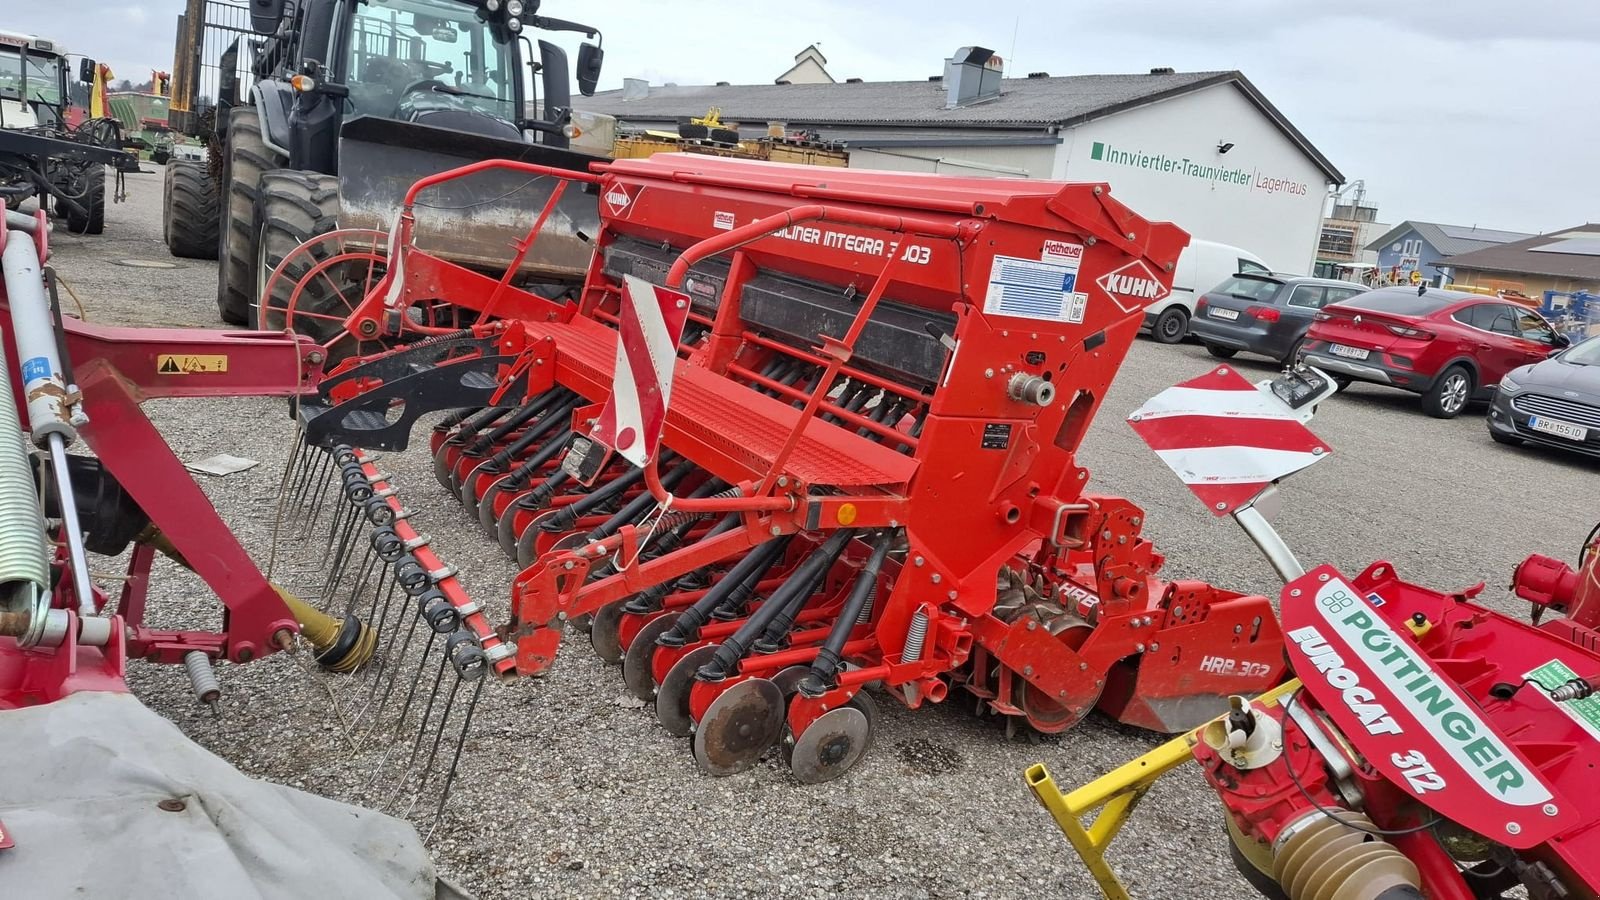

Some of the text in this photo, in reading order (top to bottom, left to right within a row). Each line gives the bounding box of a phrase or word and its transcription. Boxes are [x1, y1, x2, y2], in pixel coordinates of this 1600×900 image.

[1106, 145, 1308, 196] Innviertler-Traunviertler Lagerhaus
[823, 230, 884, 257] INTEGRA
[1106, 273, 1159, 298] KUHN
[1537, 420, 1550, 429] BR
[1555, 424, 1570, 435] 155
[1287, 625, 1446, 795] EUROCAT 312
